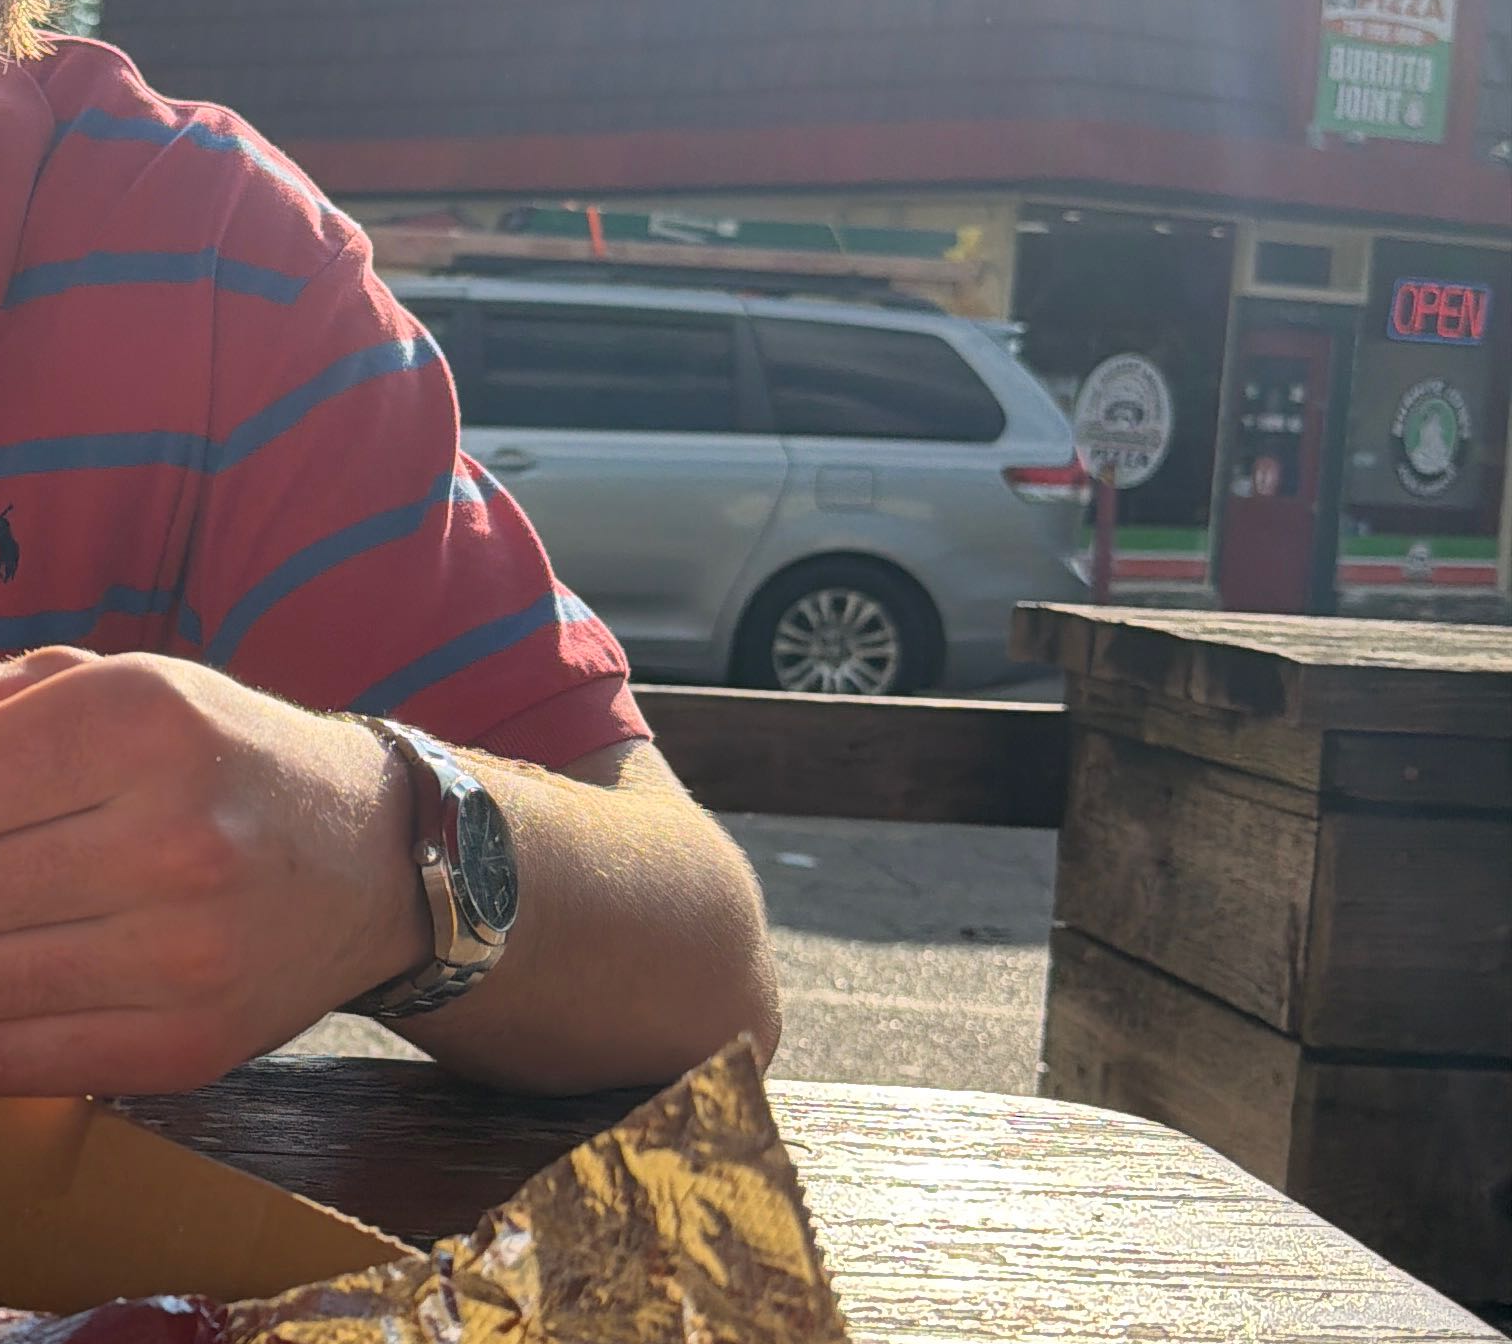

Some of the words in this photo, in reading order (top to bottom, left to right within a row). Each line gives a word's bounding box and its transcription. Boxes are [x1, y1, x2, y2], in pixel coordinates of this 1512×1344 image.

[1328, 46, 1432, 92] BURRITO
[1336, 84, 1402, 123] JOINT
[1393, 283, 1486, 339] OPEN
